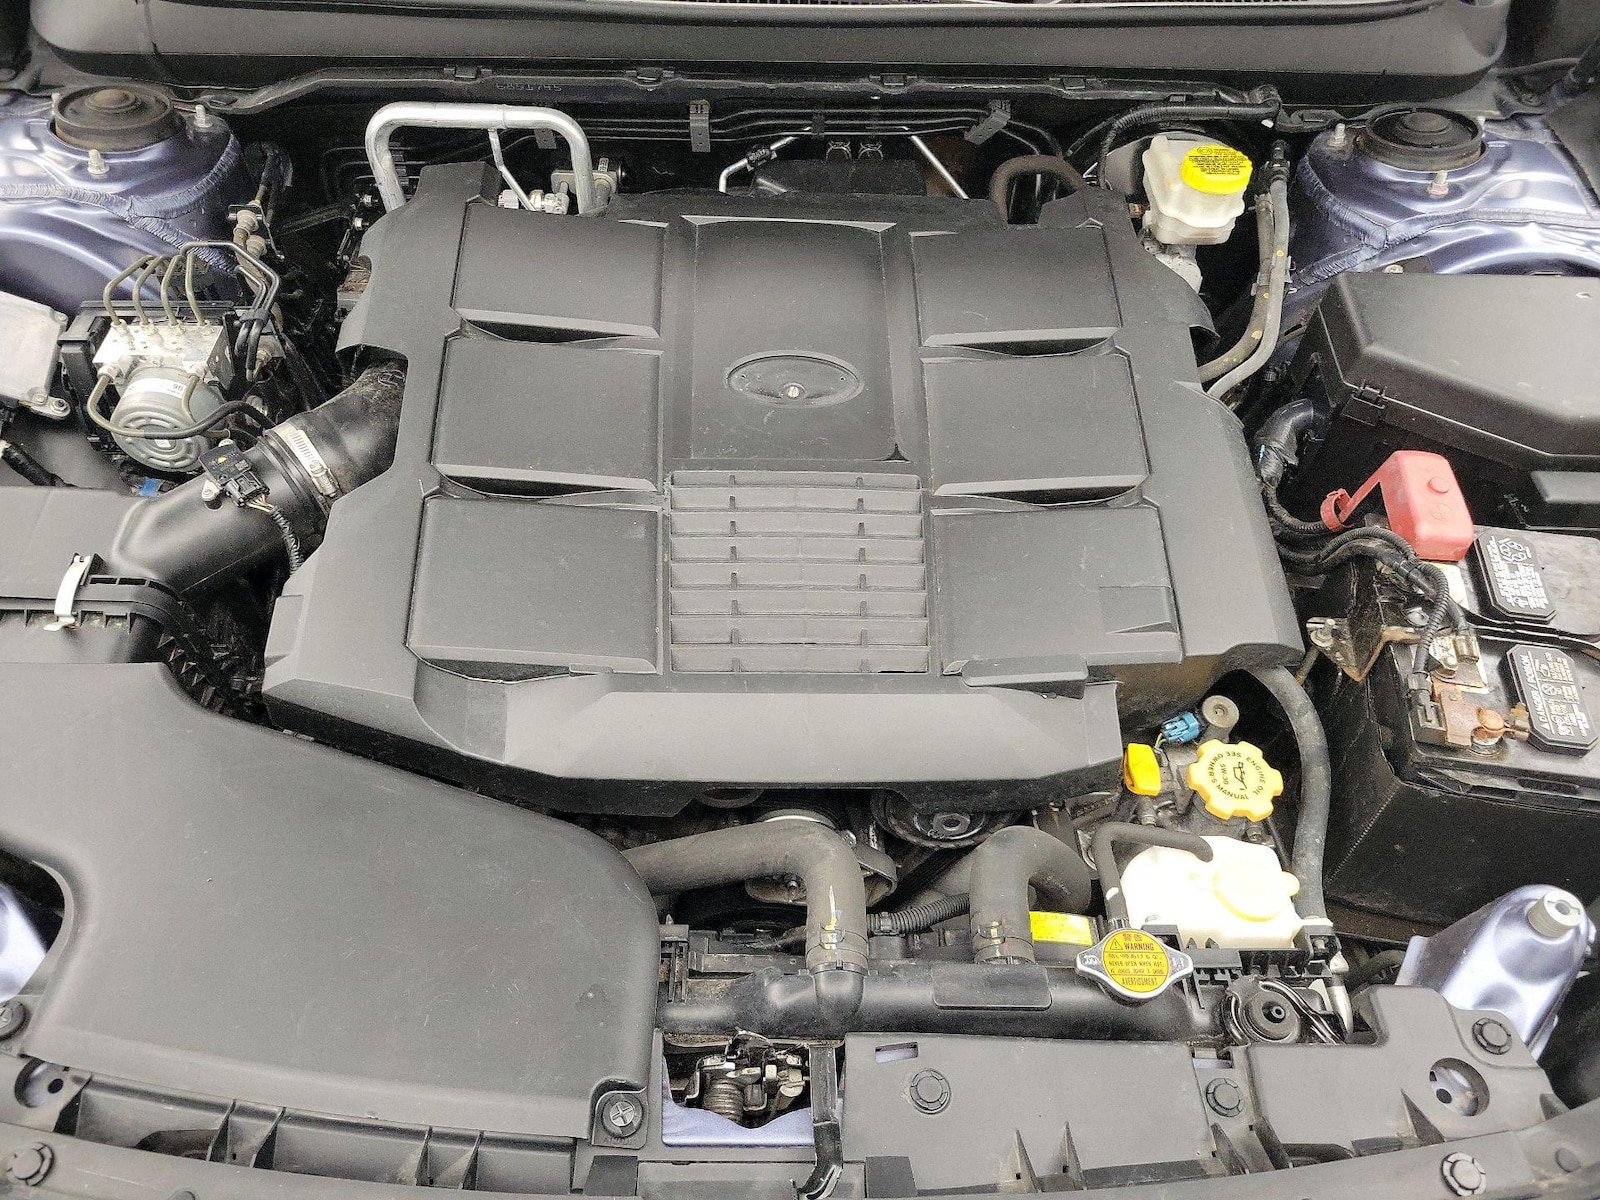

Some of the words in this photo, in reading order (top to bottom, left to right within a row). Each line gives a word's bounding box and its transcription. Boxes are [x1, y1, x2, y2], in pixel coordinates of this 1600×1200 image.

[1519, 654, 1537, 684] POISON
[1530, 690, 1548, 725] DANGER
[1219, 763, 1229, 785] 5W-30
[1246, 756, 1266, 784] ENGINE
[1216, 784, 1249, 800] MANUAL
[1252, 785, 1264, 796] OIL
[1124, 942, 1154, 951] WARNING
